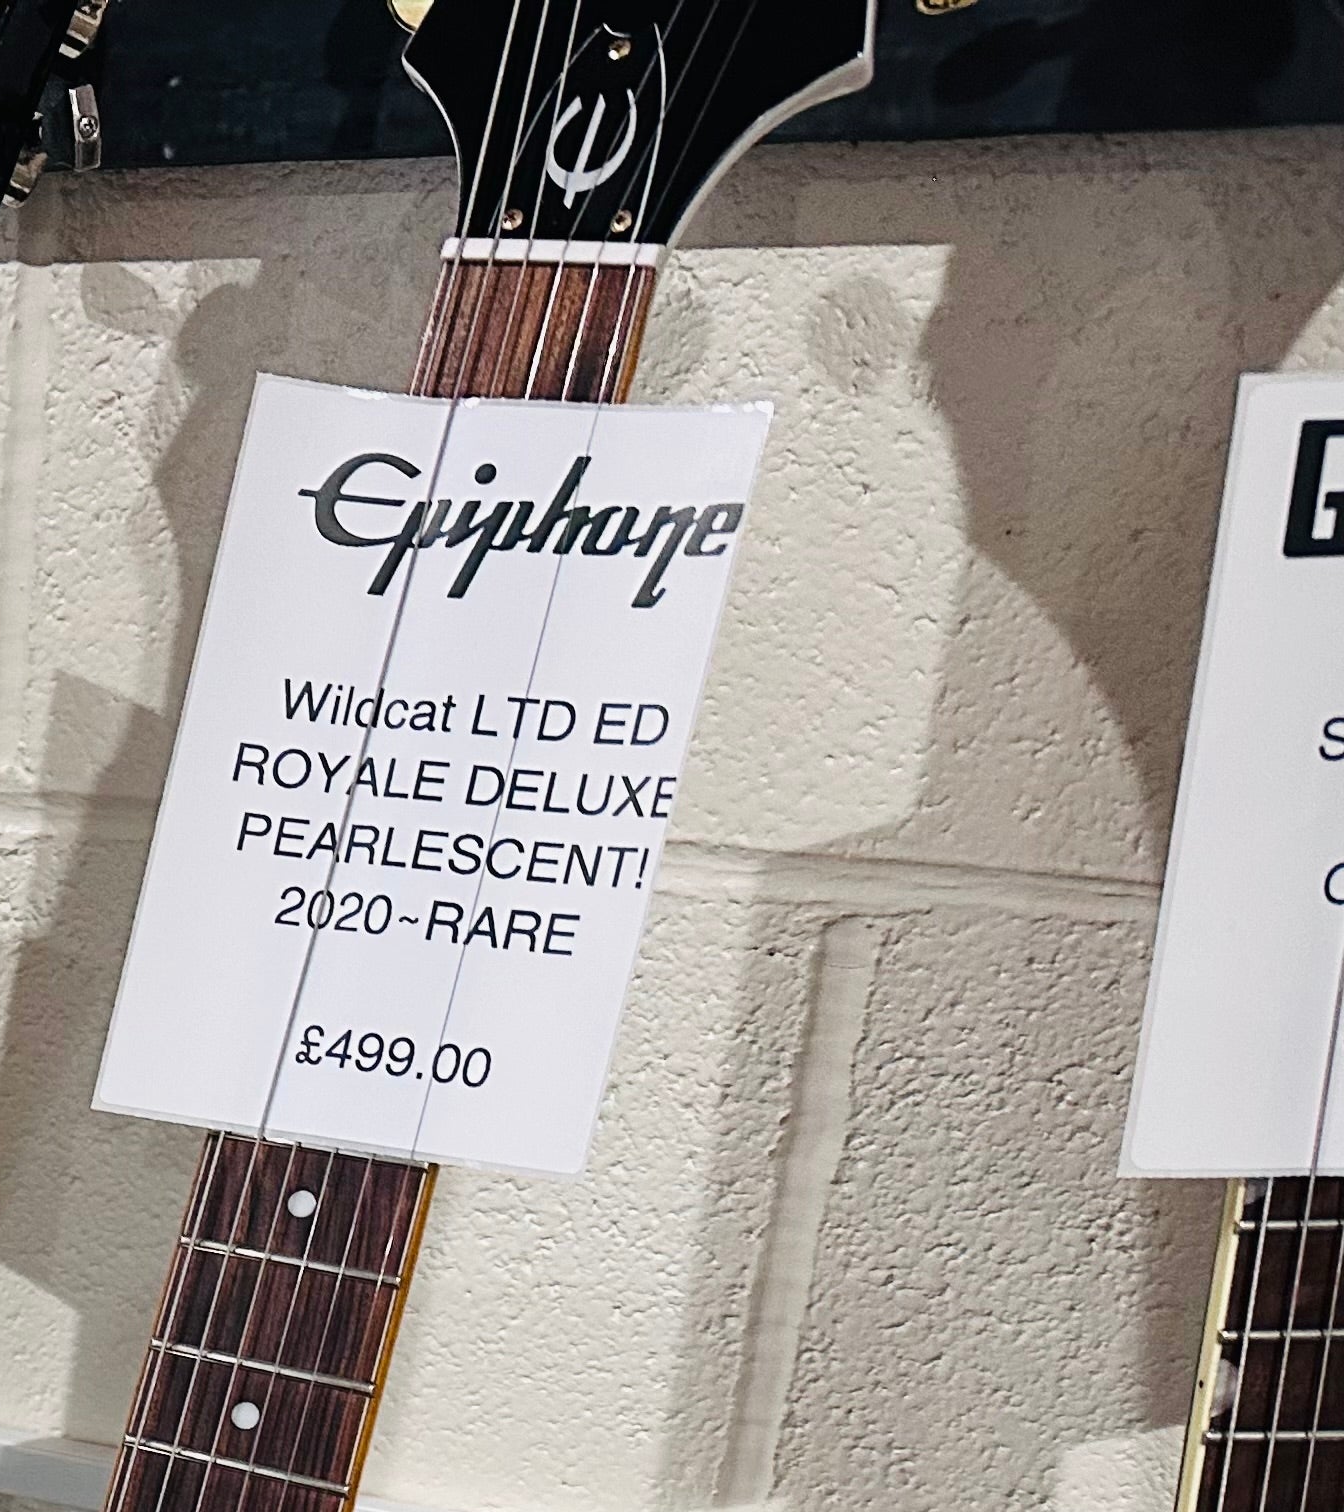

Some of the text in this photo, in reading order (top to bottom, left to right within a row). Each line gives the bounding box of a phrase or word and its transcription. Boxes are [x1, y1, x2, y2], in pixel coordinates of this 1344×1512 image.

[297, 452, 744, 609] Epiphone
[283, 679, 669, 746] Wildcat LTD ED
[232, 743, 677, 819] ROYALE DELUXE
[237, 813, 650, 889] PEARLESCENT!
[295, 1025, 493, 1088] £499.00
